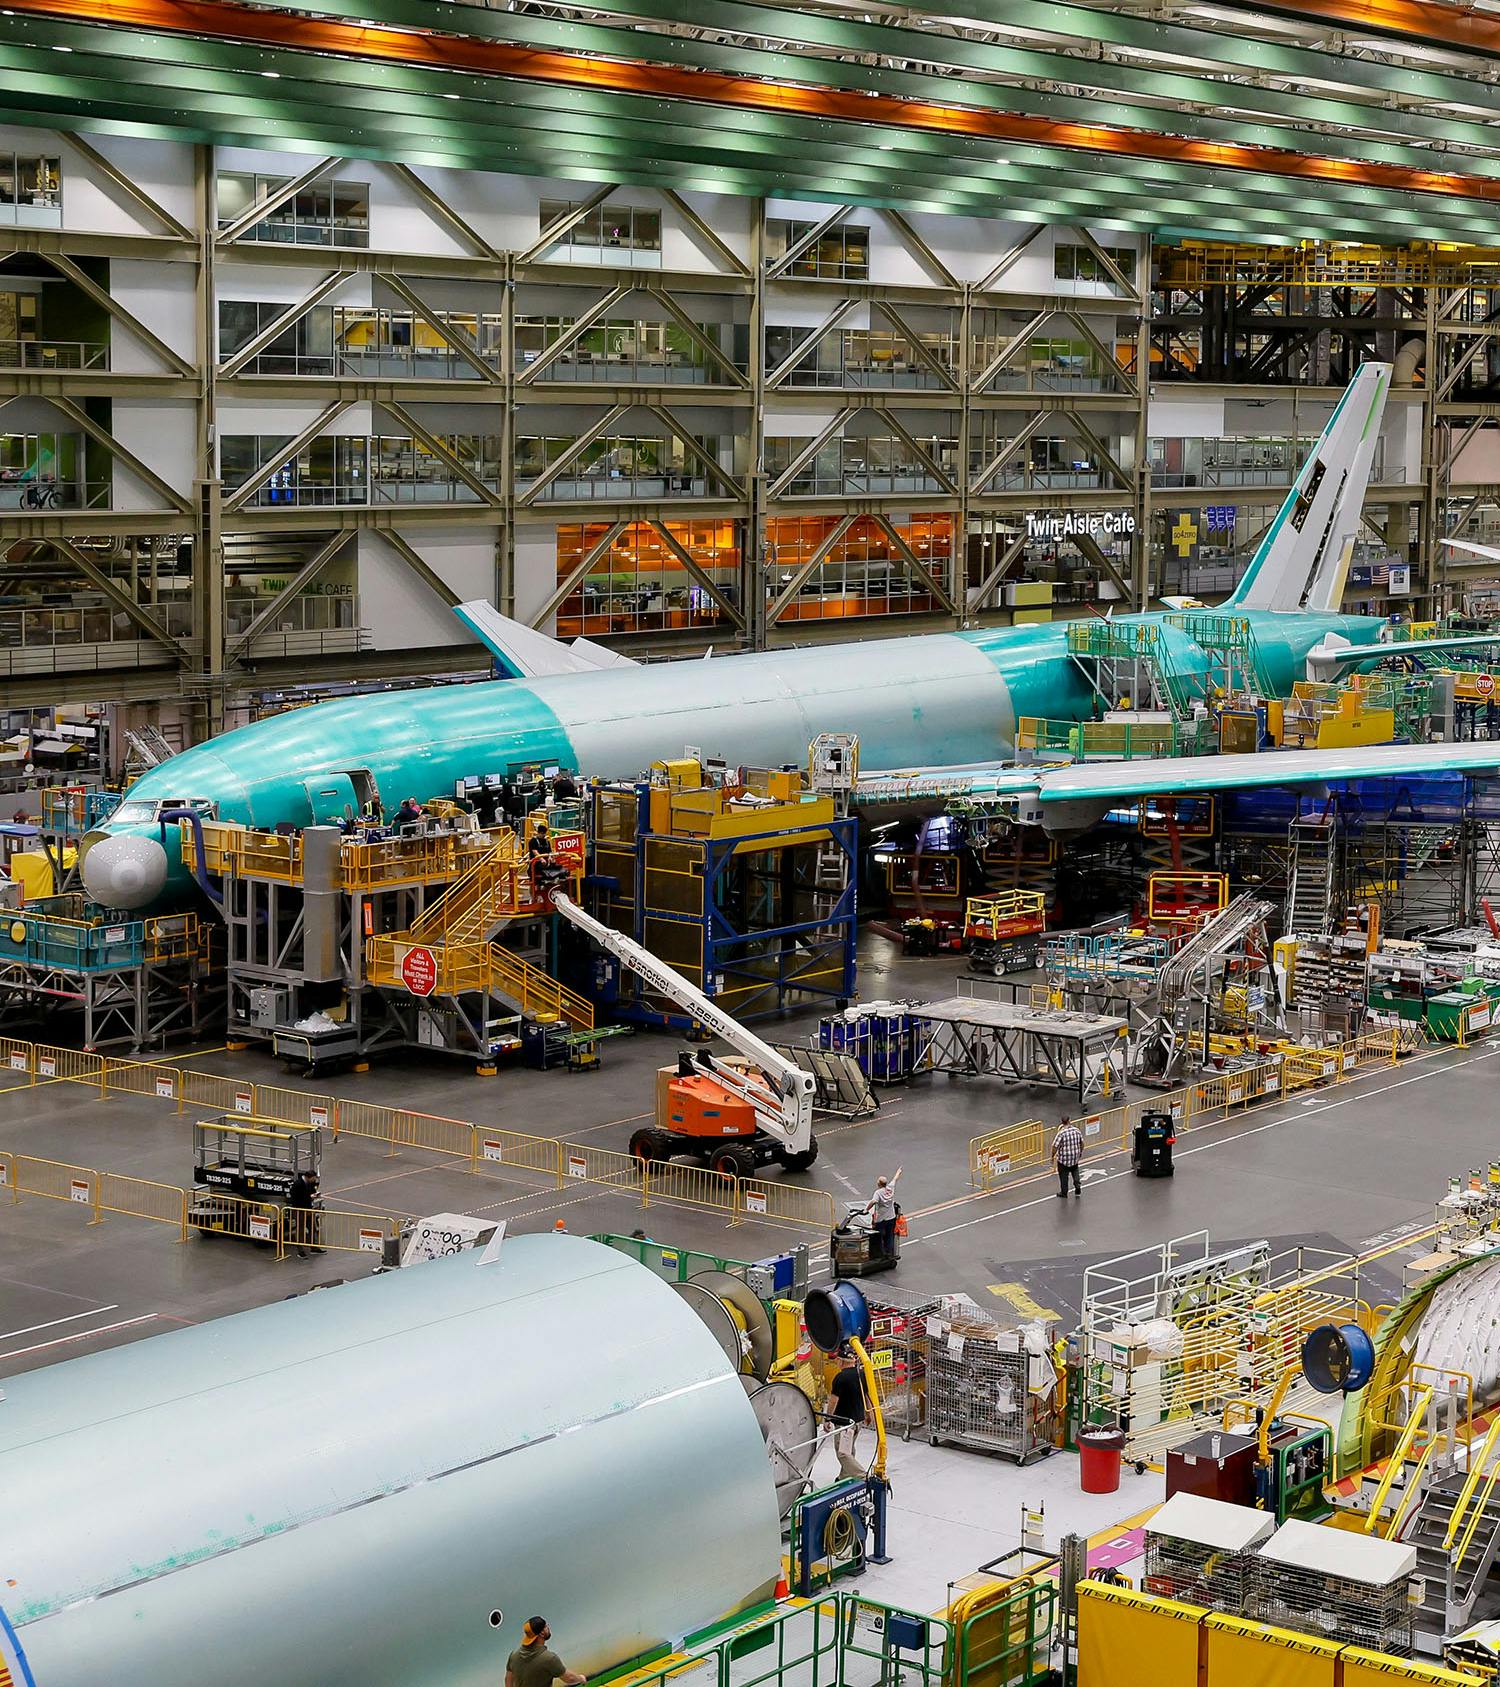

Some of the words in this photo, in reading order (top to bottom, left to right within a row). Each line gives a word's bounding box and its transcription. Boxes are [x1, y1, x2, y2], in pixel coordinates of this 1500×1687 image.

[1026, 513, 1059, 537] Twin
[1063, 512, 1099, 535] Aisle
[1103, 511, 1135, 534] Cafe
[1477, 679, 1493, 688] STOP
[557, 838, 579, 850] STOP!
[416, 952, 425, 960] ALL
[872, 1353, 892, 1364] WIP
